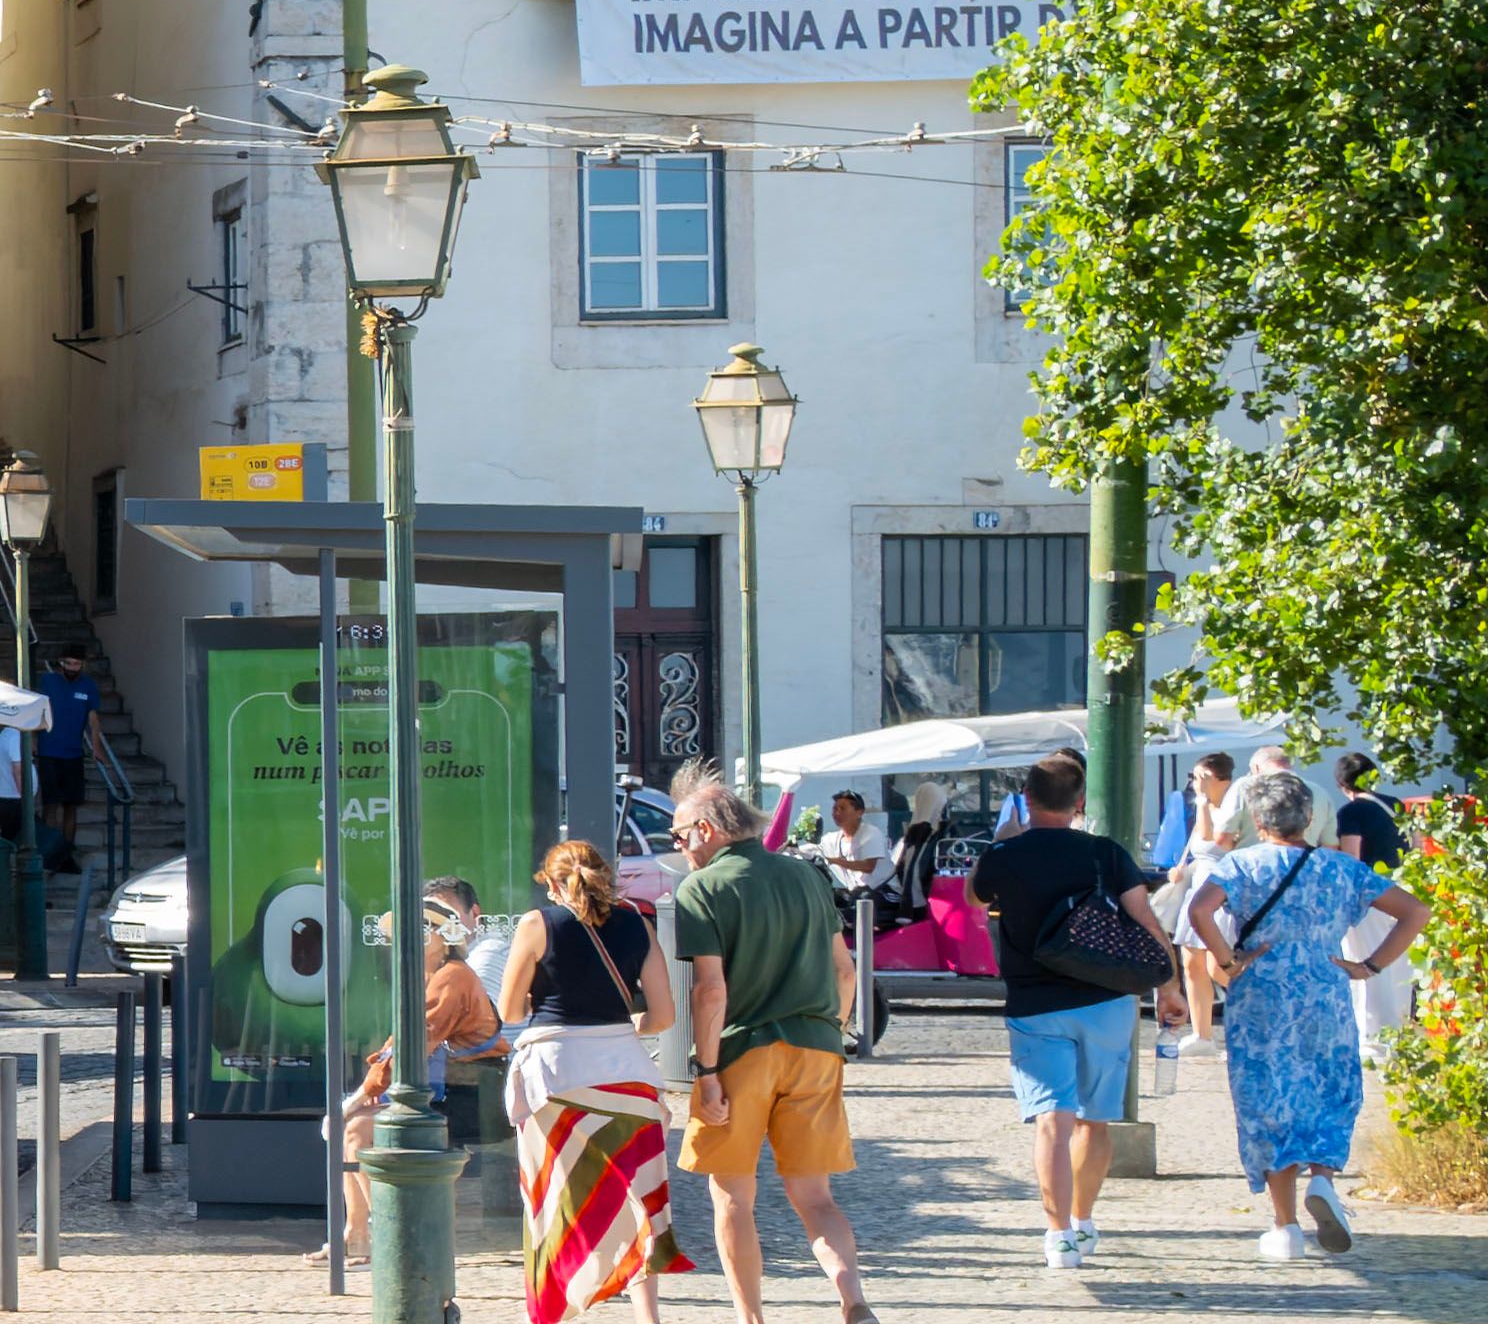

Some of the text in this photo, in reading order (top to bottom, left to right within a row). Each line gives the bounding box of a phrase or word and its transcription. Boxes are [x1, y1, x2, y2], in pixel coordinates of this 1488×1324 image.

[633, 10, 825, 53] IMAGINA
[837, 8, 868, 50] A
[878, 4, 1023, 49] PARTIR
[276, 736, 309, 755] Vê
[253, 764, 305, 781] num
[427, 760, 486, 779] olhos
